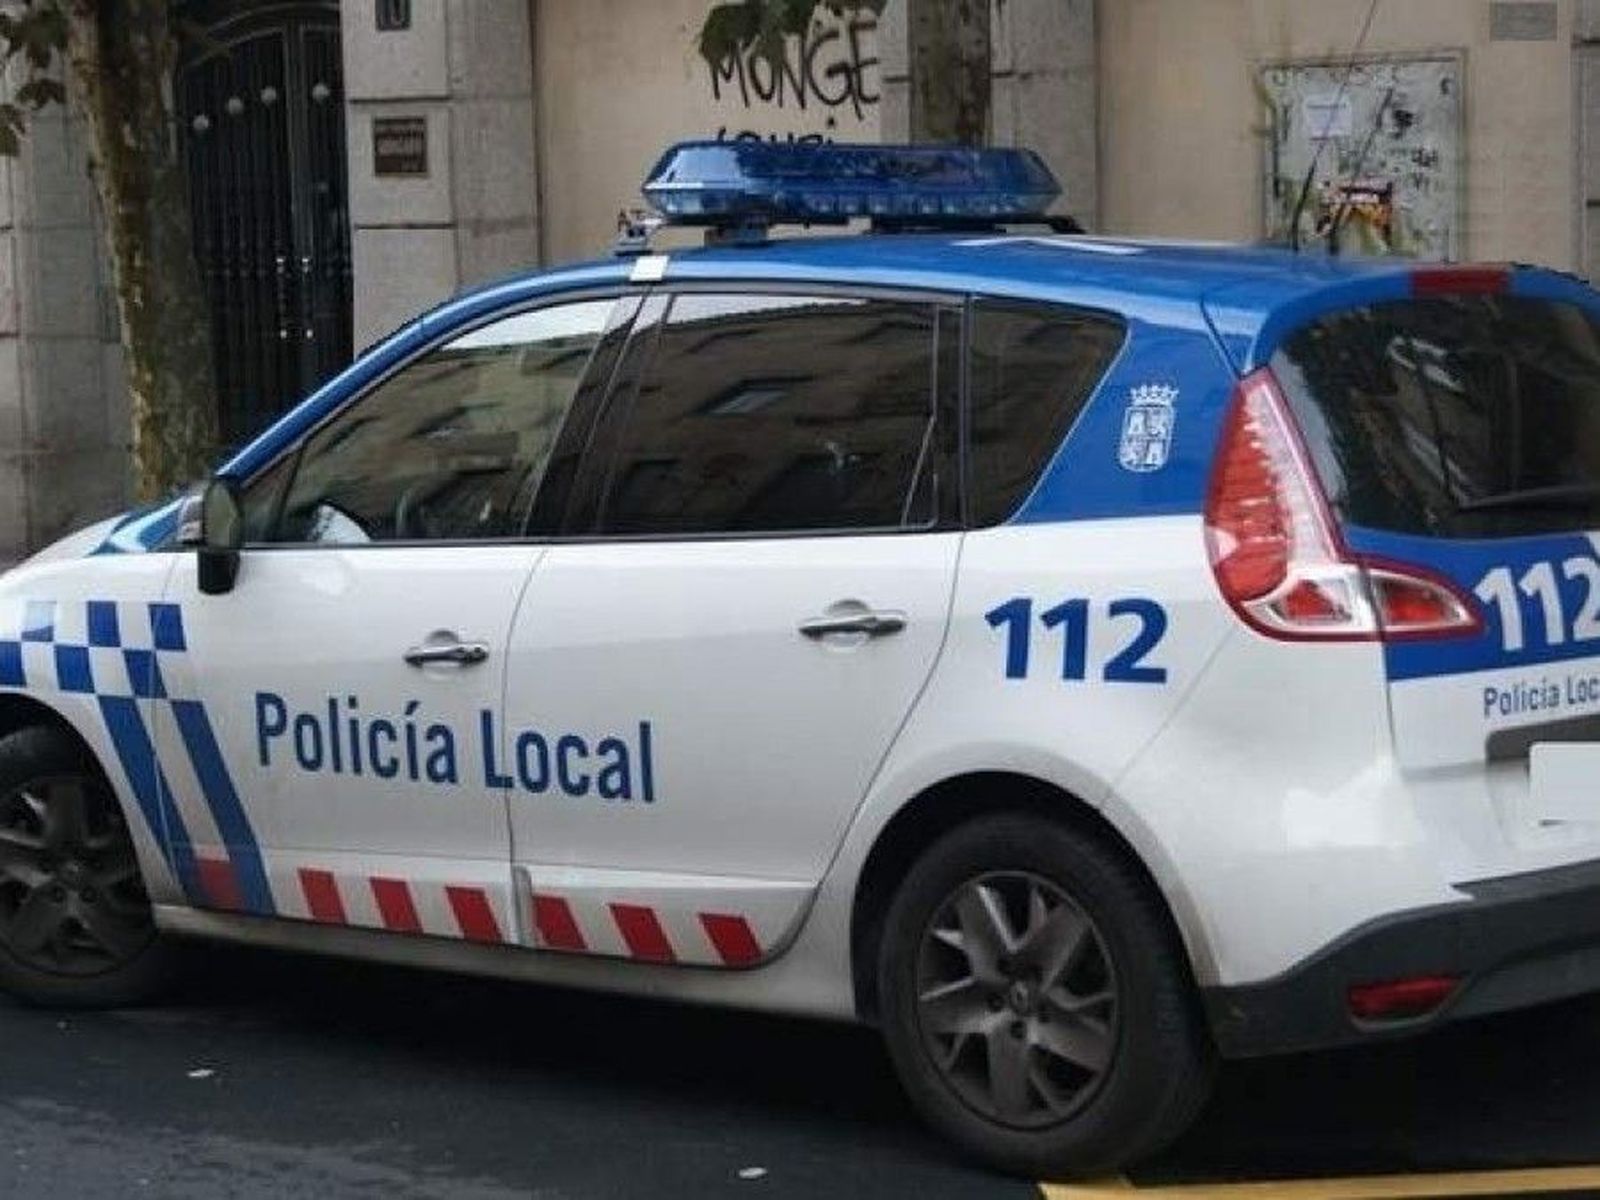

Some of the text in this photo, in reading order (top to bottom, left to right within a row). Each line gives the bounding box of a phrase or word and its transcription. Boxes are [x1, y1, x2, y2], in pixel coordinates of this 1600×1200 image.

[984, 598, 1168, 684] 112
[1474, 556, 1600, 650] 112
[255, 692, 656, 804] Policía Local
